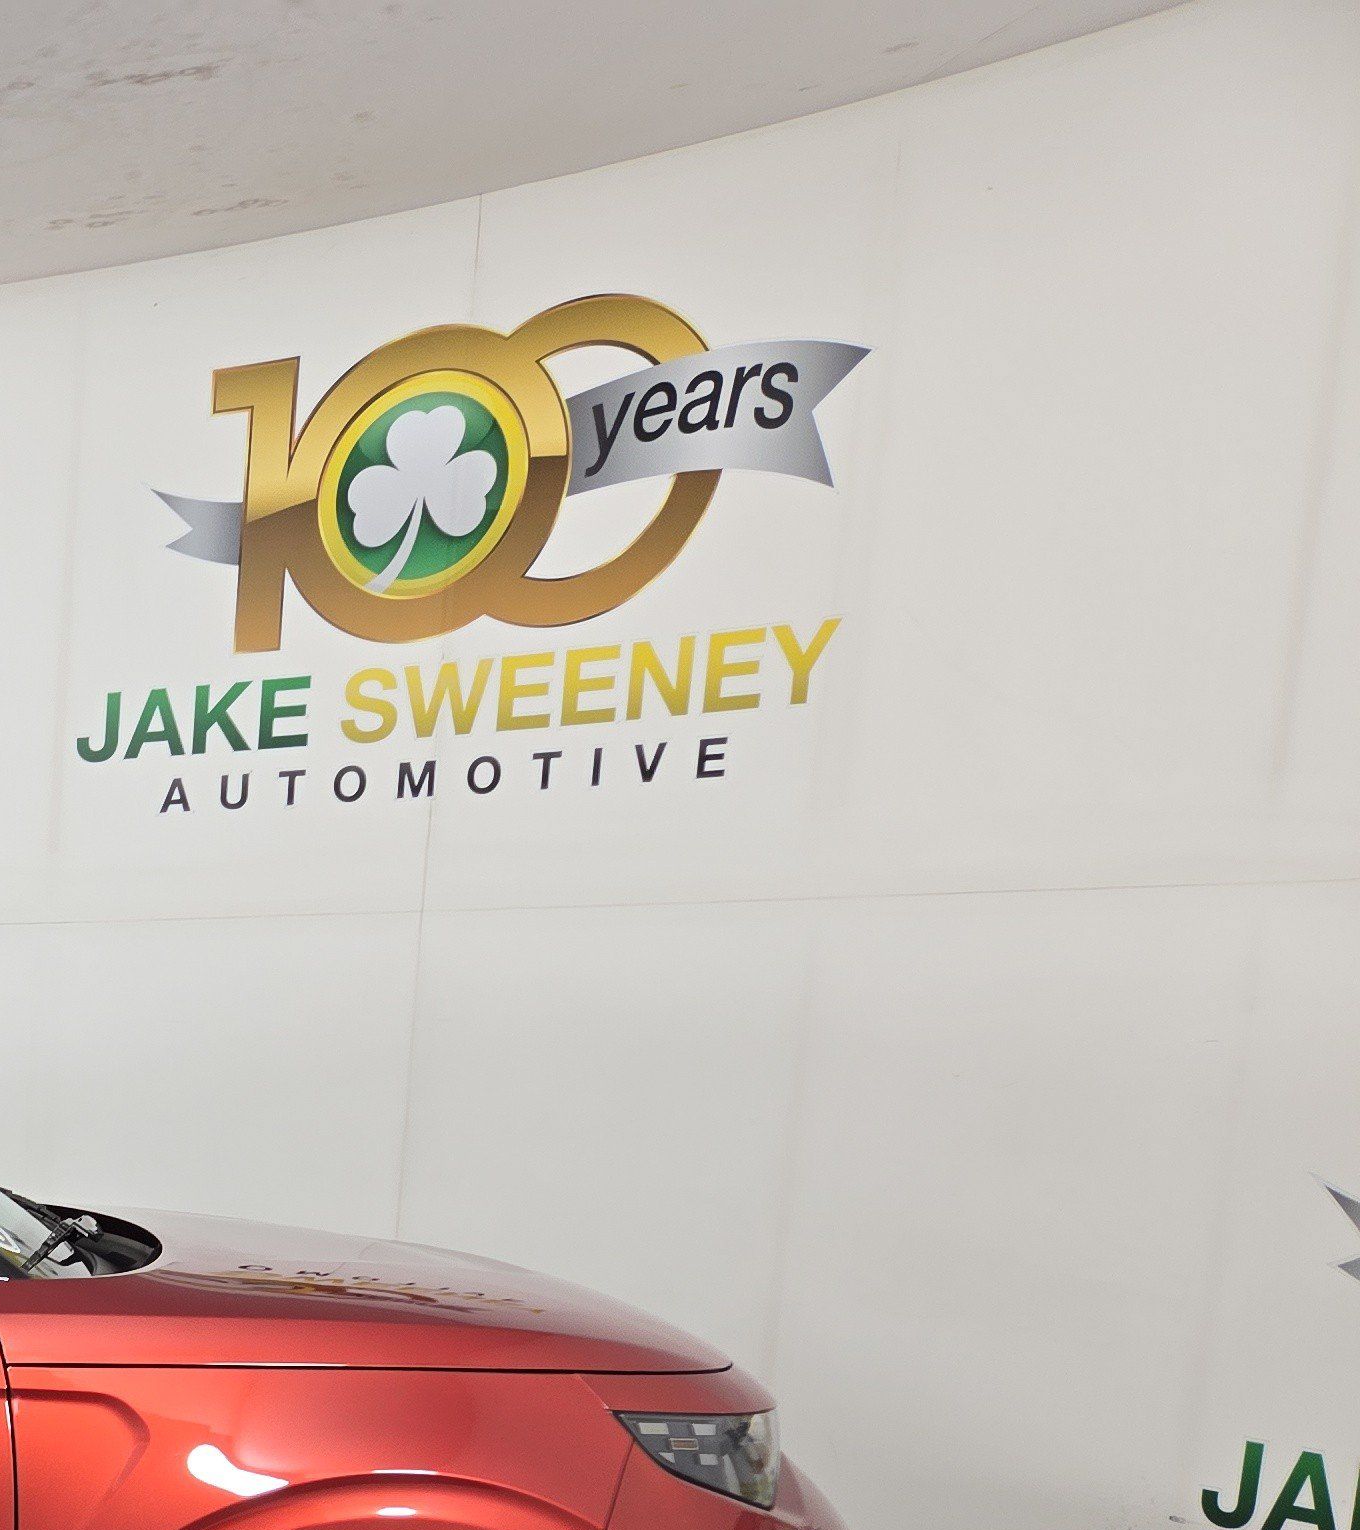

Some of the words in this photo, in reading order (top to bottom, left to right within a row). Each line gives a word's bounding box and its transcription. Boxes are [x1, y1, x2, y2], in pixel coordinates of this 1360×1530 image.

[583, 361, 800, 477] years
[76, 675, 312, 764] JAKE
[339, 617, 843, 745] SWEENEY
[159, 736, 728, 814] AUTOMOTIVE
